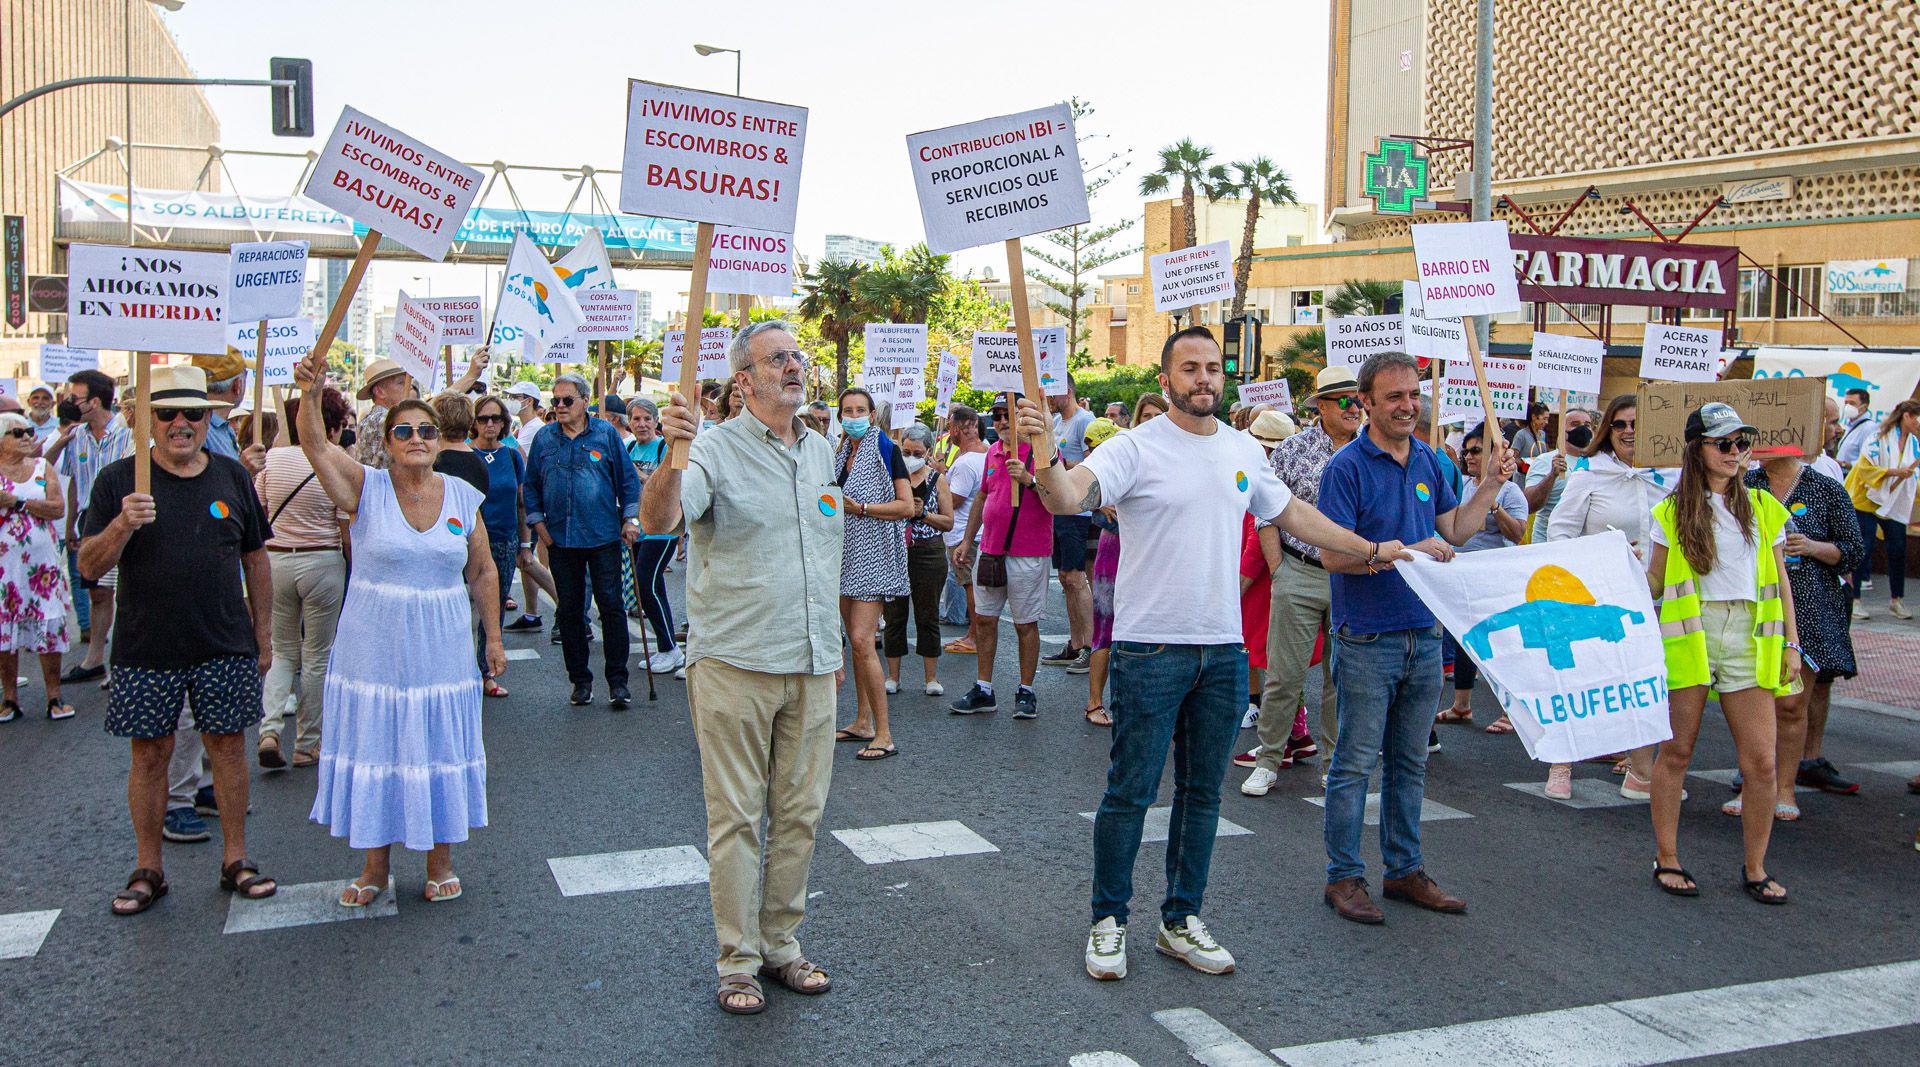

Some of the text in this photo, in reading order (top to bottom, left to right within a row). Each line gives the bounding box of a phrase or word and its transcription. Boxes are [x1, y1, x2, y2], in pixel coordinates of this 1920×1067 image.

[642, 99, 798, 138] ¡VIVIMOS ENTRE
[645, 128, 788, 165] ESCOMBROS &
[920, 130, 1026, 162] CONTRIBUCION
[1028, 120, 1053, 139] IBI
[346, 120, 473, 192] ¡VIVIMOS ENTRE
[931, 144, 1065, 185] PROPORCIONAL A
[341, 143, 456, 210] ESCOMBROS &
[646, 164, 780, 202] BASURAS!
[946, 168, 1059, 205] SERVICIOS QUE
[332, 170, 443, 234] BASURAS!
[965, 193, 1049, 224] RECIBIMOS
[153, 202, 345, 224] SOS ALBUFERETA
[479, 220, 498, 232] DE
[607, 226, 674, 242] ALICANTE
[238, 248, 305, 264] REPARACIONES
[1165, 256, 1188, 266] FAIRE
[1190, 250, 1209, 260] RIEN
[709, 258, 788, 274] NDIGNADOS
[1164, 260, 1220, 279] UNE OFFENSE
[1422, 258, 1490, 277] BARRIO EN
[1512, 249, 1726, 294] FARMACIA
[82, 278, 219, 299] AHOGAMOS
[235, 270, 302, 288] URGENTES:
[1162, 272, 1226, 292] AUX VOISINS ET
[1828, 270, 1856, 292] SOS
[1160, 282, 1230, 304] AUX VISITEURS!!!
[1426, 282, 1496, 300] ABANDONO
[11, 294, 20, 324] MOON
[80, 300, 222, 322] EN MIERDA!
[443, 301, 478, 310] RIESGO
[580, 304, 632, 312] YUNTAMIENTO
[403, 302, 435, 334] ALBUFERETA
[1338, 320, 1402, 334] 50 AÑOS DE
[406, 321, 428, 346] NEEDS A
[1411, 324, 1460, 340] NEGLIGENTES
[1662, 330, 1708, 344] ACERAS
[395, 332, 434, 369] HOLISTIC PLAN!
[898, 346, 915, 354] PLAN
[1332, 336, 1391, 350] PROMESAS
[1660, 344, 1708, 358] PONER Y
[546, 352, 569, 360] OTAL!
[986, 350, 1016, 360] CALAS
[1538, 350, 1598, 364] SEÑALIZACIONES
[1482, 361, 1526, 371] RIESGO!
[1538, 362, 1582, 374] DEFICIENTES
[1654, 358, 1710, 372] REPARAR!
[1245, 382, 1284, 394] PROYECTO
[1448, 378, 1478, 387] ROTURA
[1250, 392, 1284, 402] INTEGRAL
